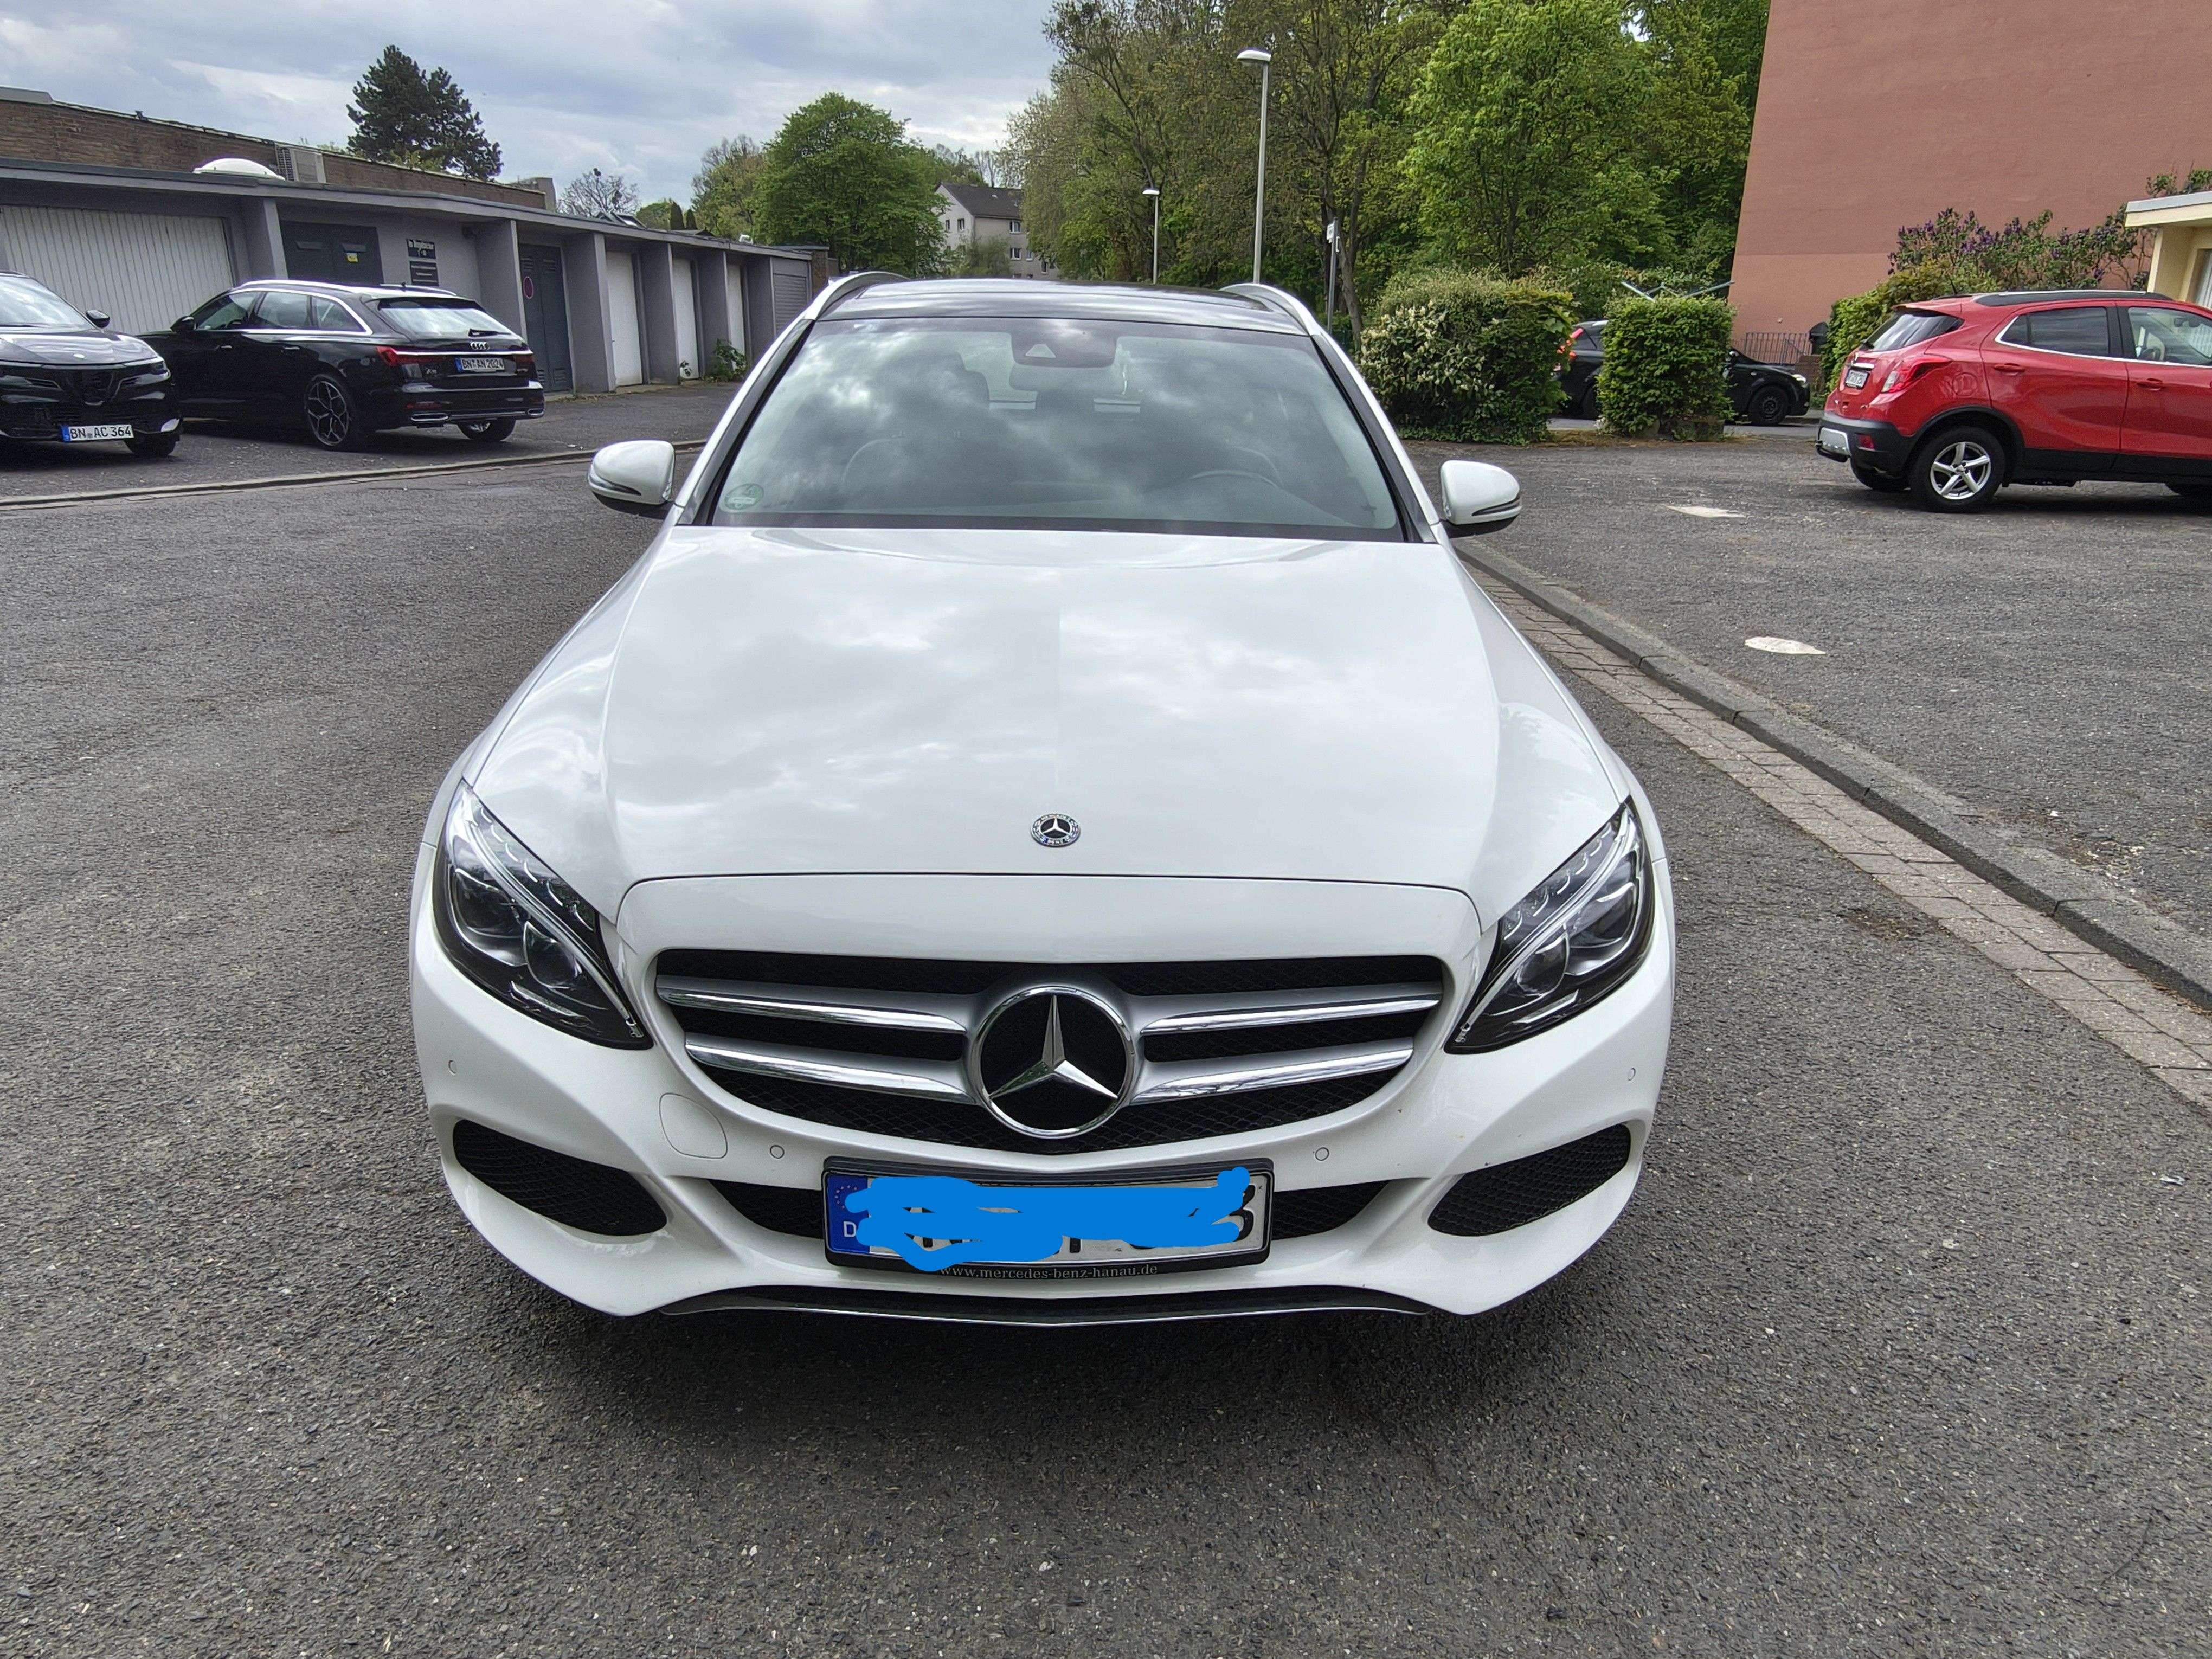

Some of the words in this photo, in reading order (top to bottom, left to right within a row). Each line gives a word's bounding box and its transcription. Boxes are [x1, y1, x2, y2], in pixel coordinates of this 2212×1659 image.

[70, 428, 86, 439] BN
[94, 426, 108, 438] AC
[110, 426, 131, 437] 364
[843, 1221, 857, 1237] D
[941, 1264, 1158, 1279] www.mercedes-benz-hanau.de
